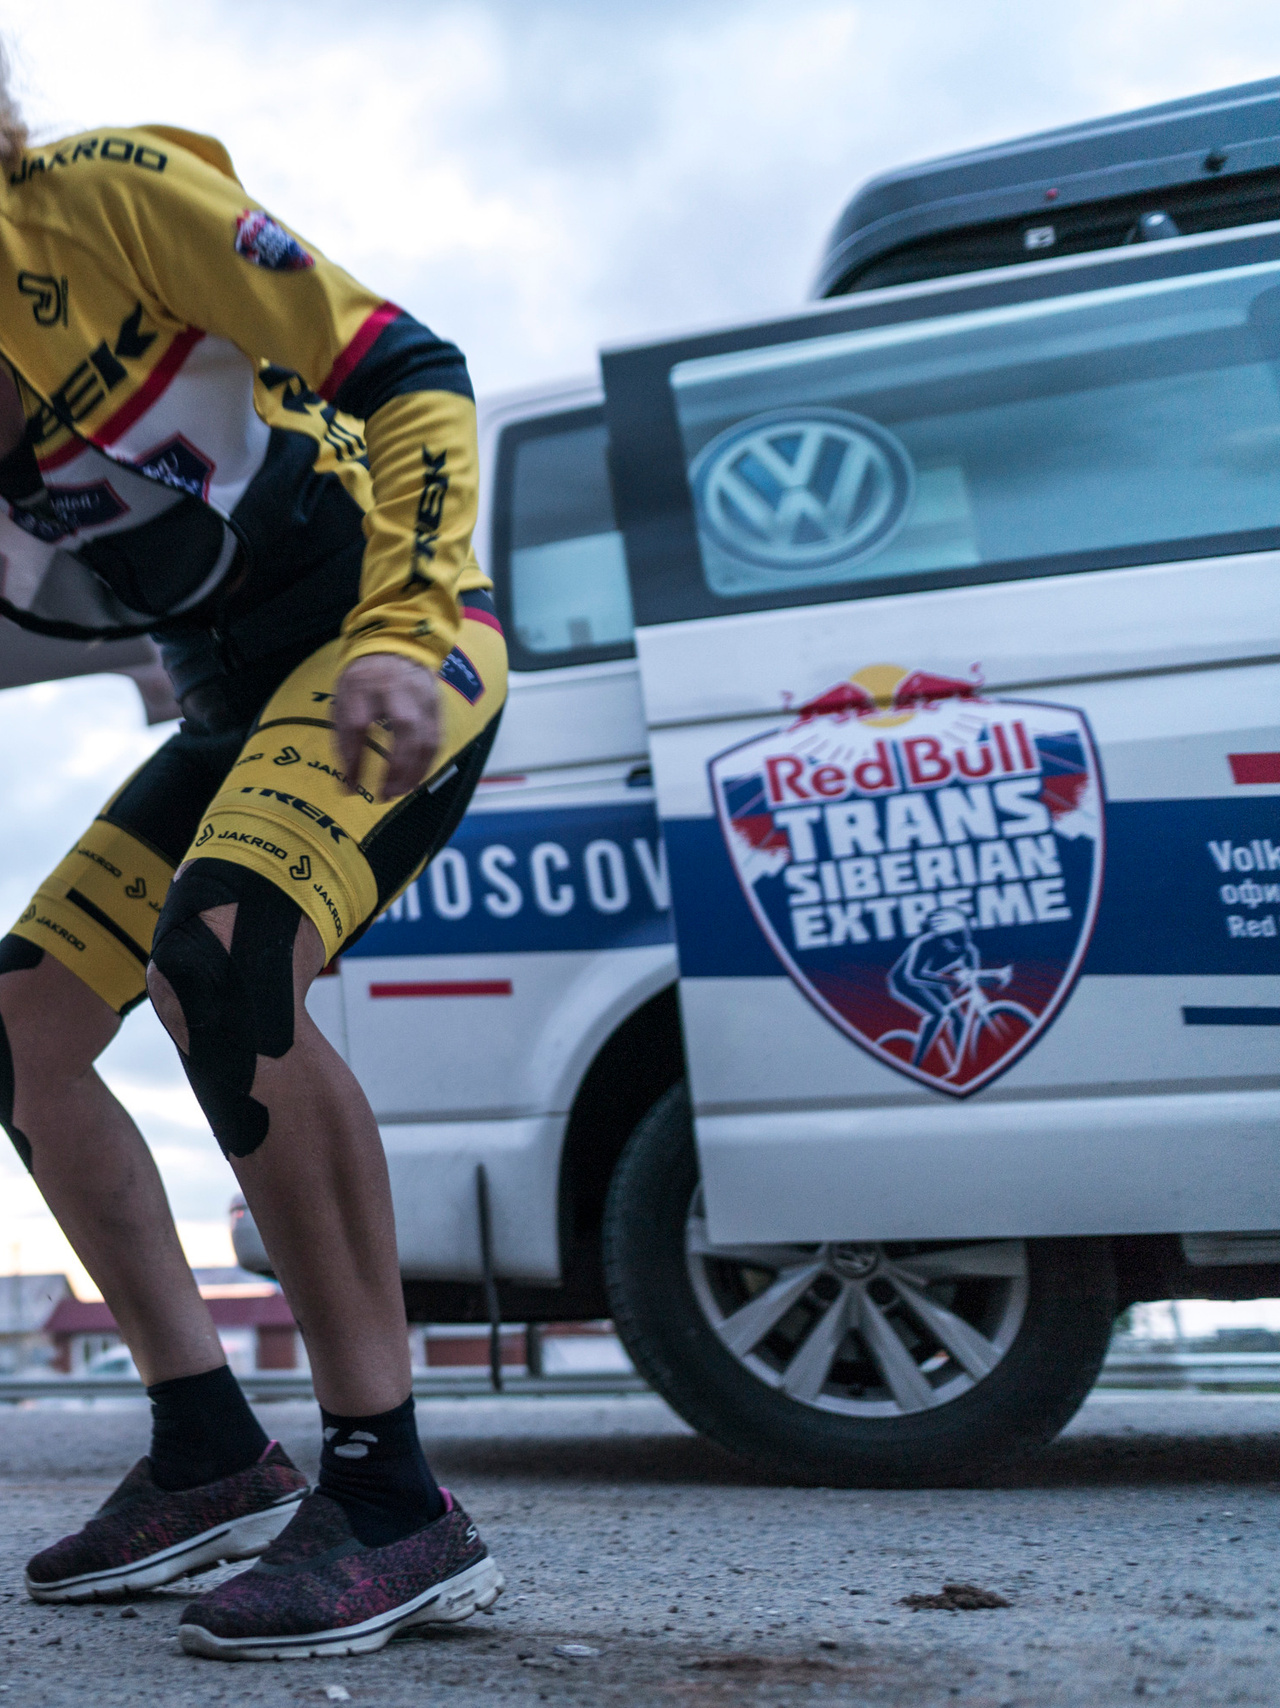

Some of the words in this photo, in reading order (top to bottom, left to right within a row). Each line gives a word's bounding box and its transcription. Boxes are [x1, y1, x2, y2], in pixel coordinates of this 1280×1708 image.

[307, 760, 375, 804] JAKOO
[766, 738, 897, 803] Red
[903, 719, 1036, 785] Bull
[240, 786, 350, 844] TREK
[773, 776, 1053, 863] TRANS
[218, 830, 288, 860] JAKROO
[313, 883, 344, 938] JAKROO
[784, 834, 1062, 907] SIBERIAN
[36, 916, 87, 952] JAKROO
[792, 878, 1072, 950] EXTREME
[1226, 914, 1277, 938] Red
